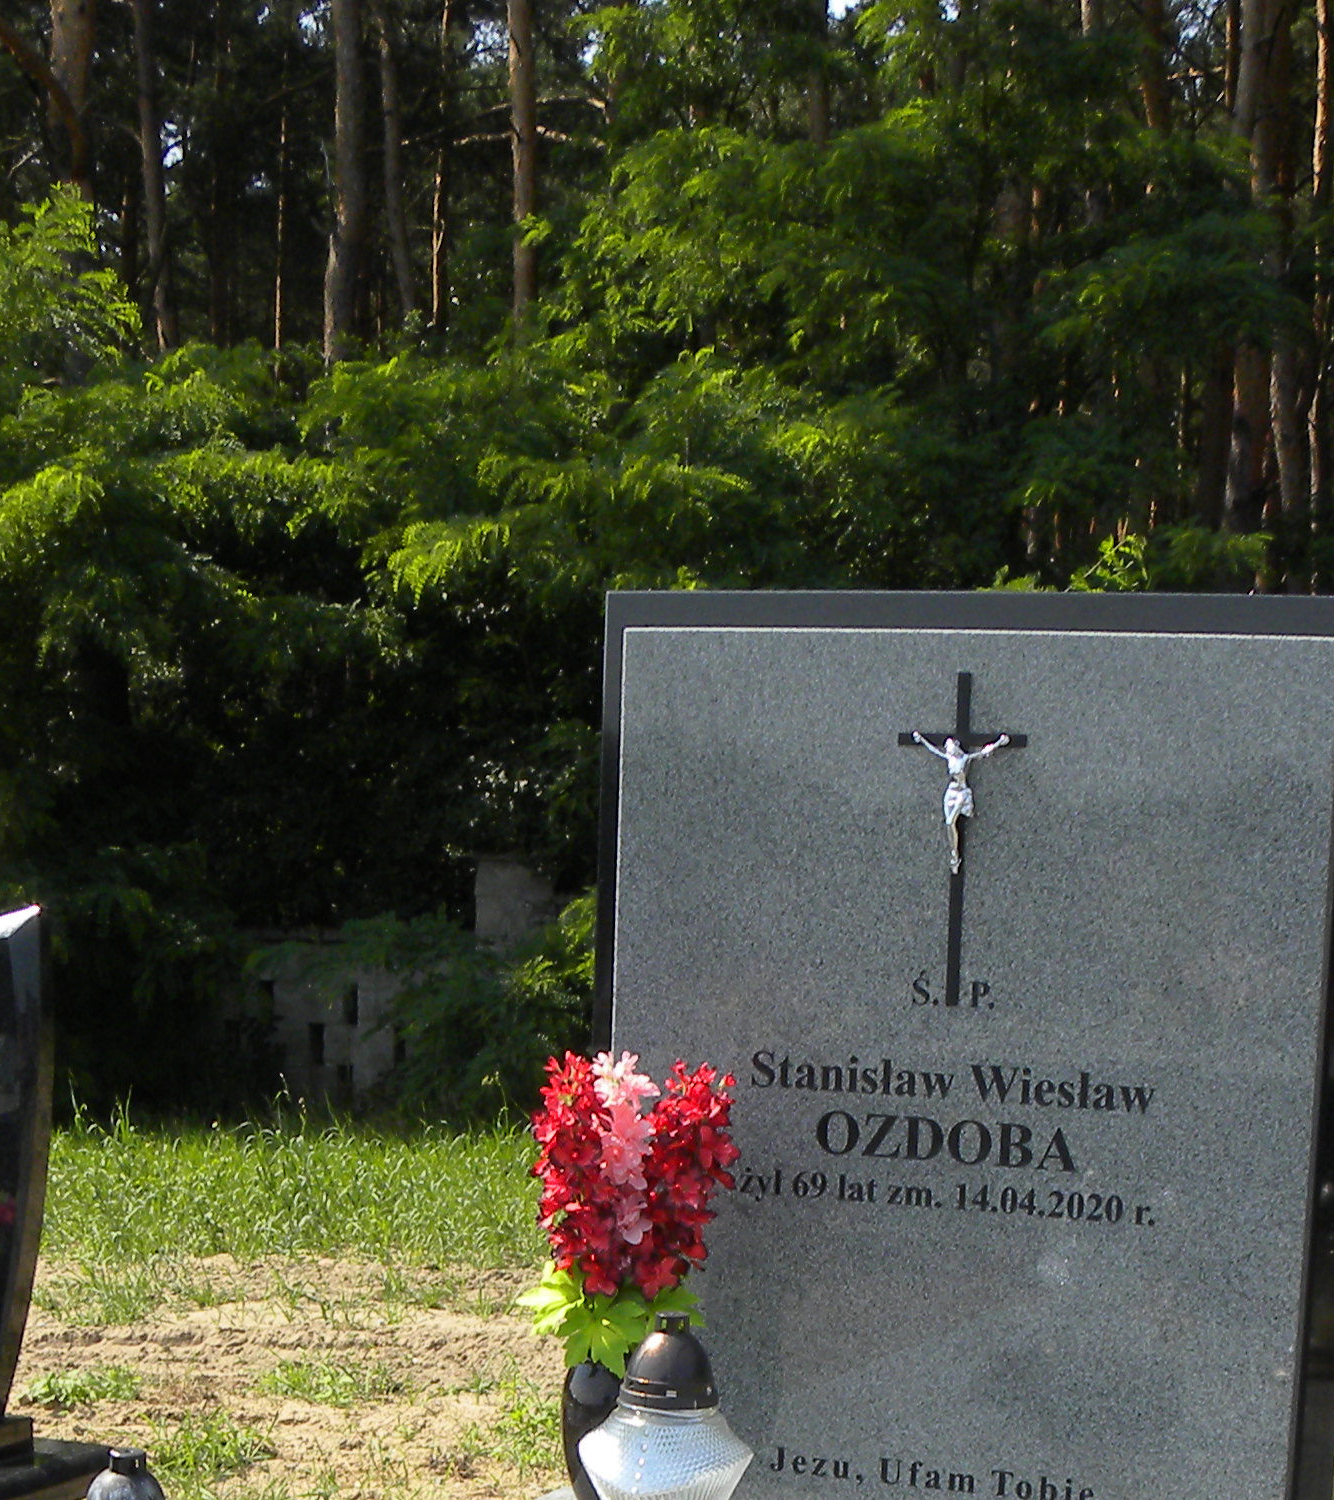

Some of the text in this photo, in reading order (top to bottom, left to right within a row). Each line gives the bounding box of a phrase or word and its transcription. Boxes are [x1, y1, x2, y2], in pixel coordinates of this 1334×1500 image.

[750, 1050, 1155, 1114] Stanisław Wiesław
[815, 1110, 1077, 1173] OZDOBA
[792, 1171, 827, 1198] 69
[838, 1174, 878, 1202] lat
[887, 1185, 942, 1209] zm.
[956, 1184, 1124, 1224] 14.04.2020
[1133, 1204, 1156, 1226] r.
[769, 1446, 864, 1484] Jezu,
[879, 1457, 975, 1495] Ufam
